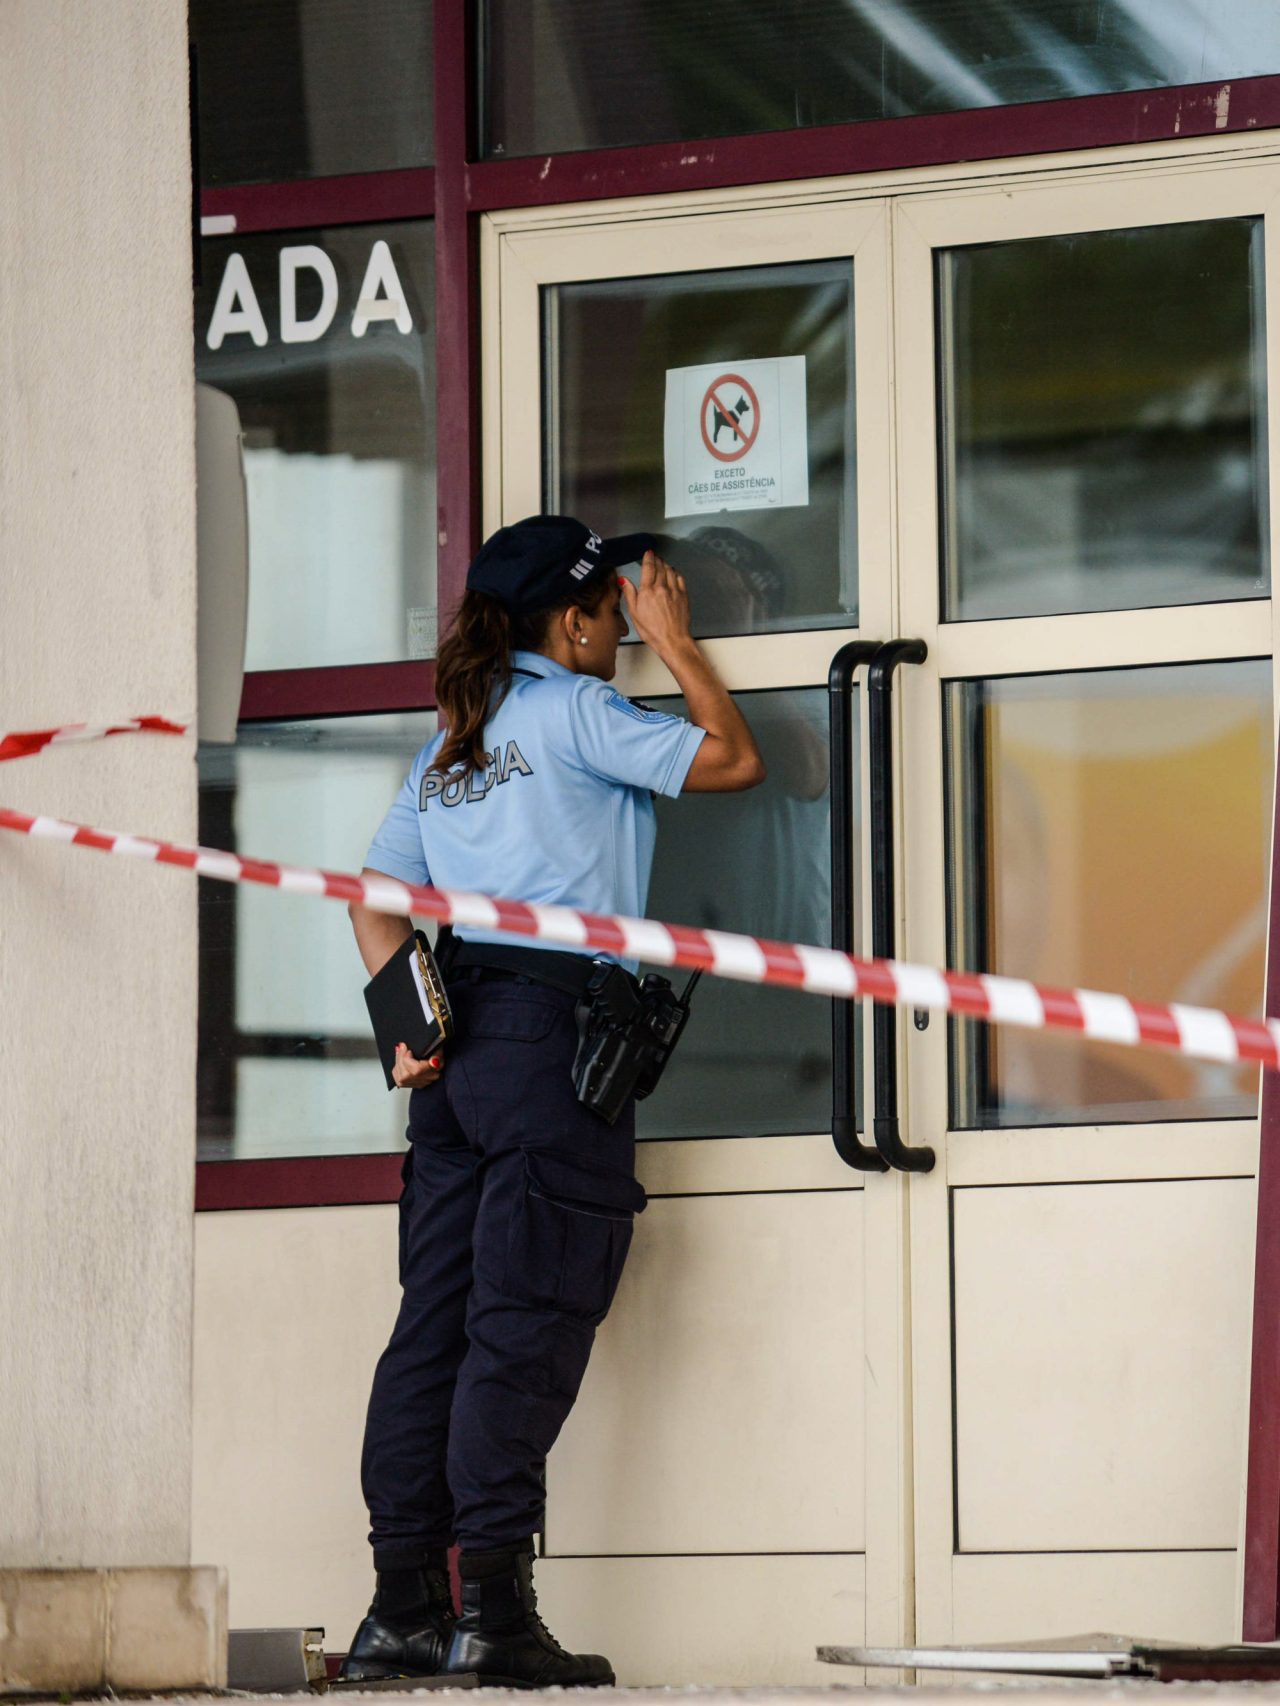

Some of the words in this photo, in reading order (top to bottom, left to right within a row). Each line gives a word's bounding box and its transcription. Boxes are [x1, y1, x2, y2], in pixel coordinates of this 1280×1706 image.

[714, 467, 746, 479] EXCETO
[688, 482, 709, 494] CÃES
[710, 481, 721, 492] DE
[722, 476, 775, 490] ASSISTÊNCIA
